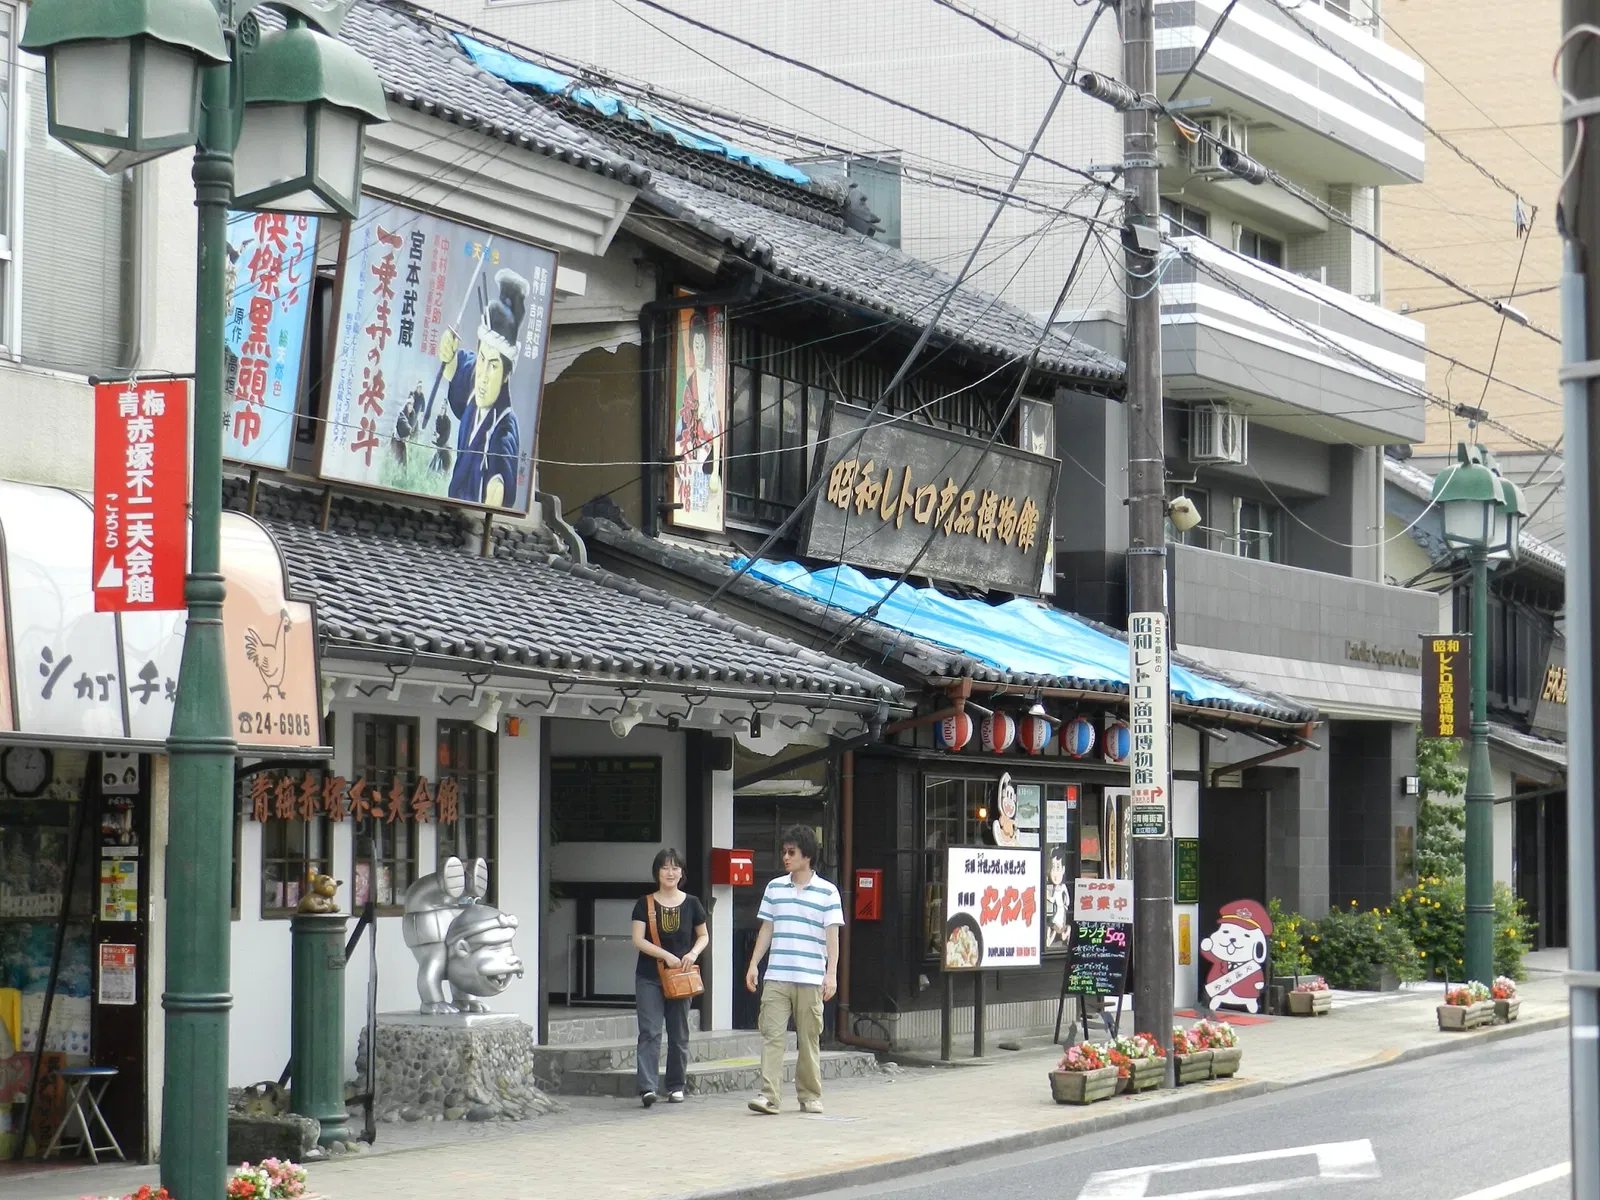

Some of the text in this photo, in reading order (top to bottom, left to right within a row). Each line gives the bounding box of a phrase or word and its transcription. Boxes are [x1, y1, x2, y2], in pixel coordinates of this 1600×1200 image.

[398, 230, 426, 348] 宮本武蔵
[233, 213, 289, 447] 快傑黒頭巾
[351, 224, 404, 467] 一乗寺の決斗
[118, 389, 166, 418] 青梅
[105, 493, 119, 549] こちら
[125, 416, 155, 604] 赤塚不二夫会館
[827, 458, 1040, 555] 昭和レトロ商品博物館
[1432, 639, 1460, 653] 昭和
[255, 712, 311, 737] 24-6985
[1133, 616, 1153, 785] 昭和レトロ商品博物館
[1438, 652, 1454, 737] レトロ商品博物館
[250, 770, 460, 824] 青梅赤塚不二夫会館
[1079, 927, 1106, 939] ランチ
[1080, 895, 1128, 912] 営業中
